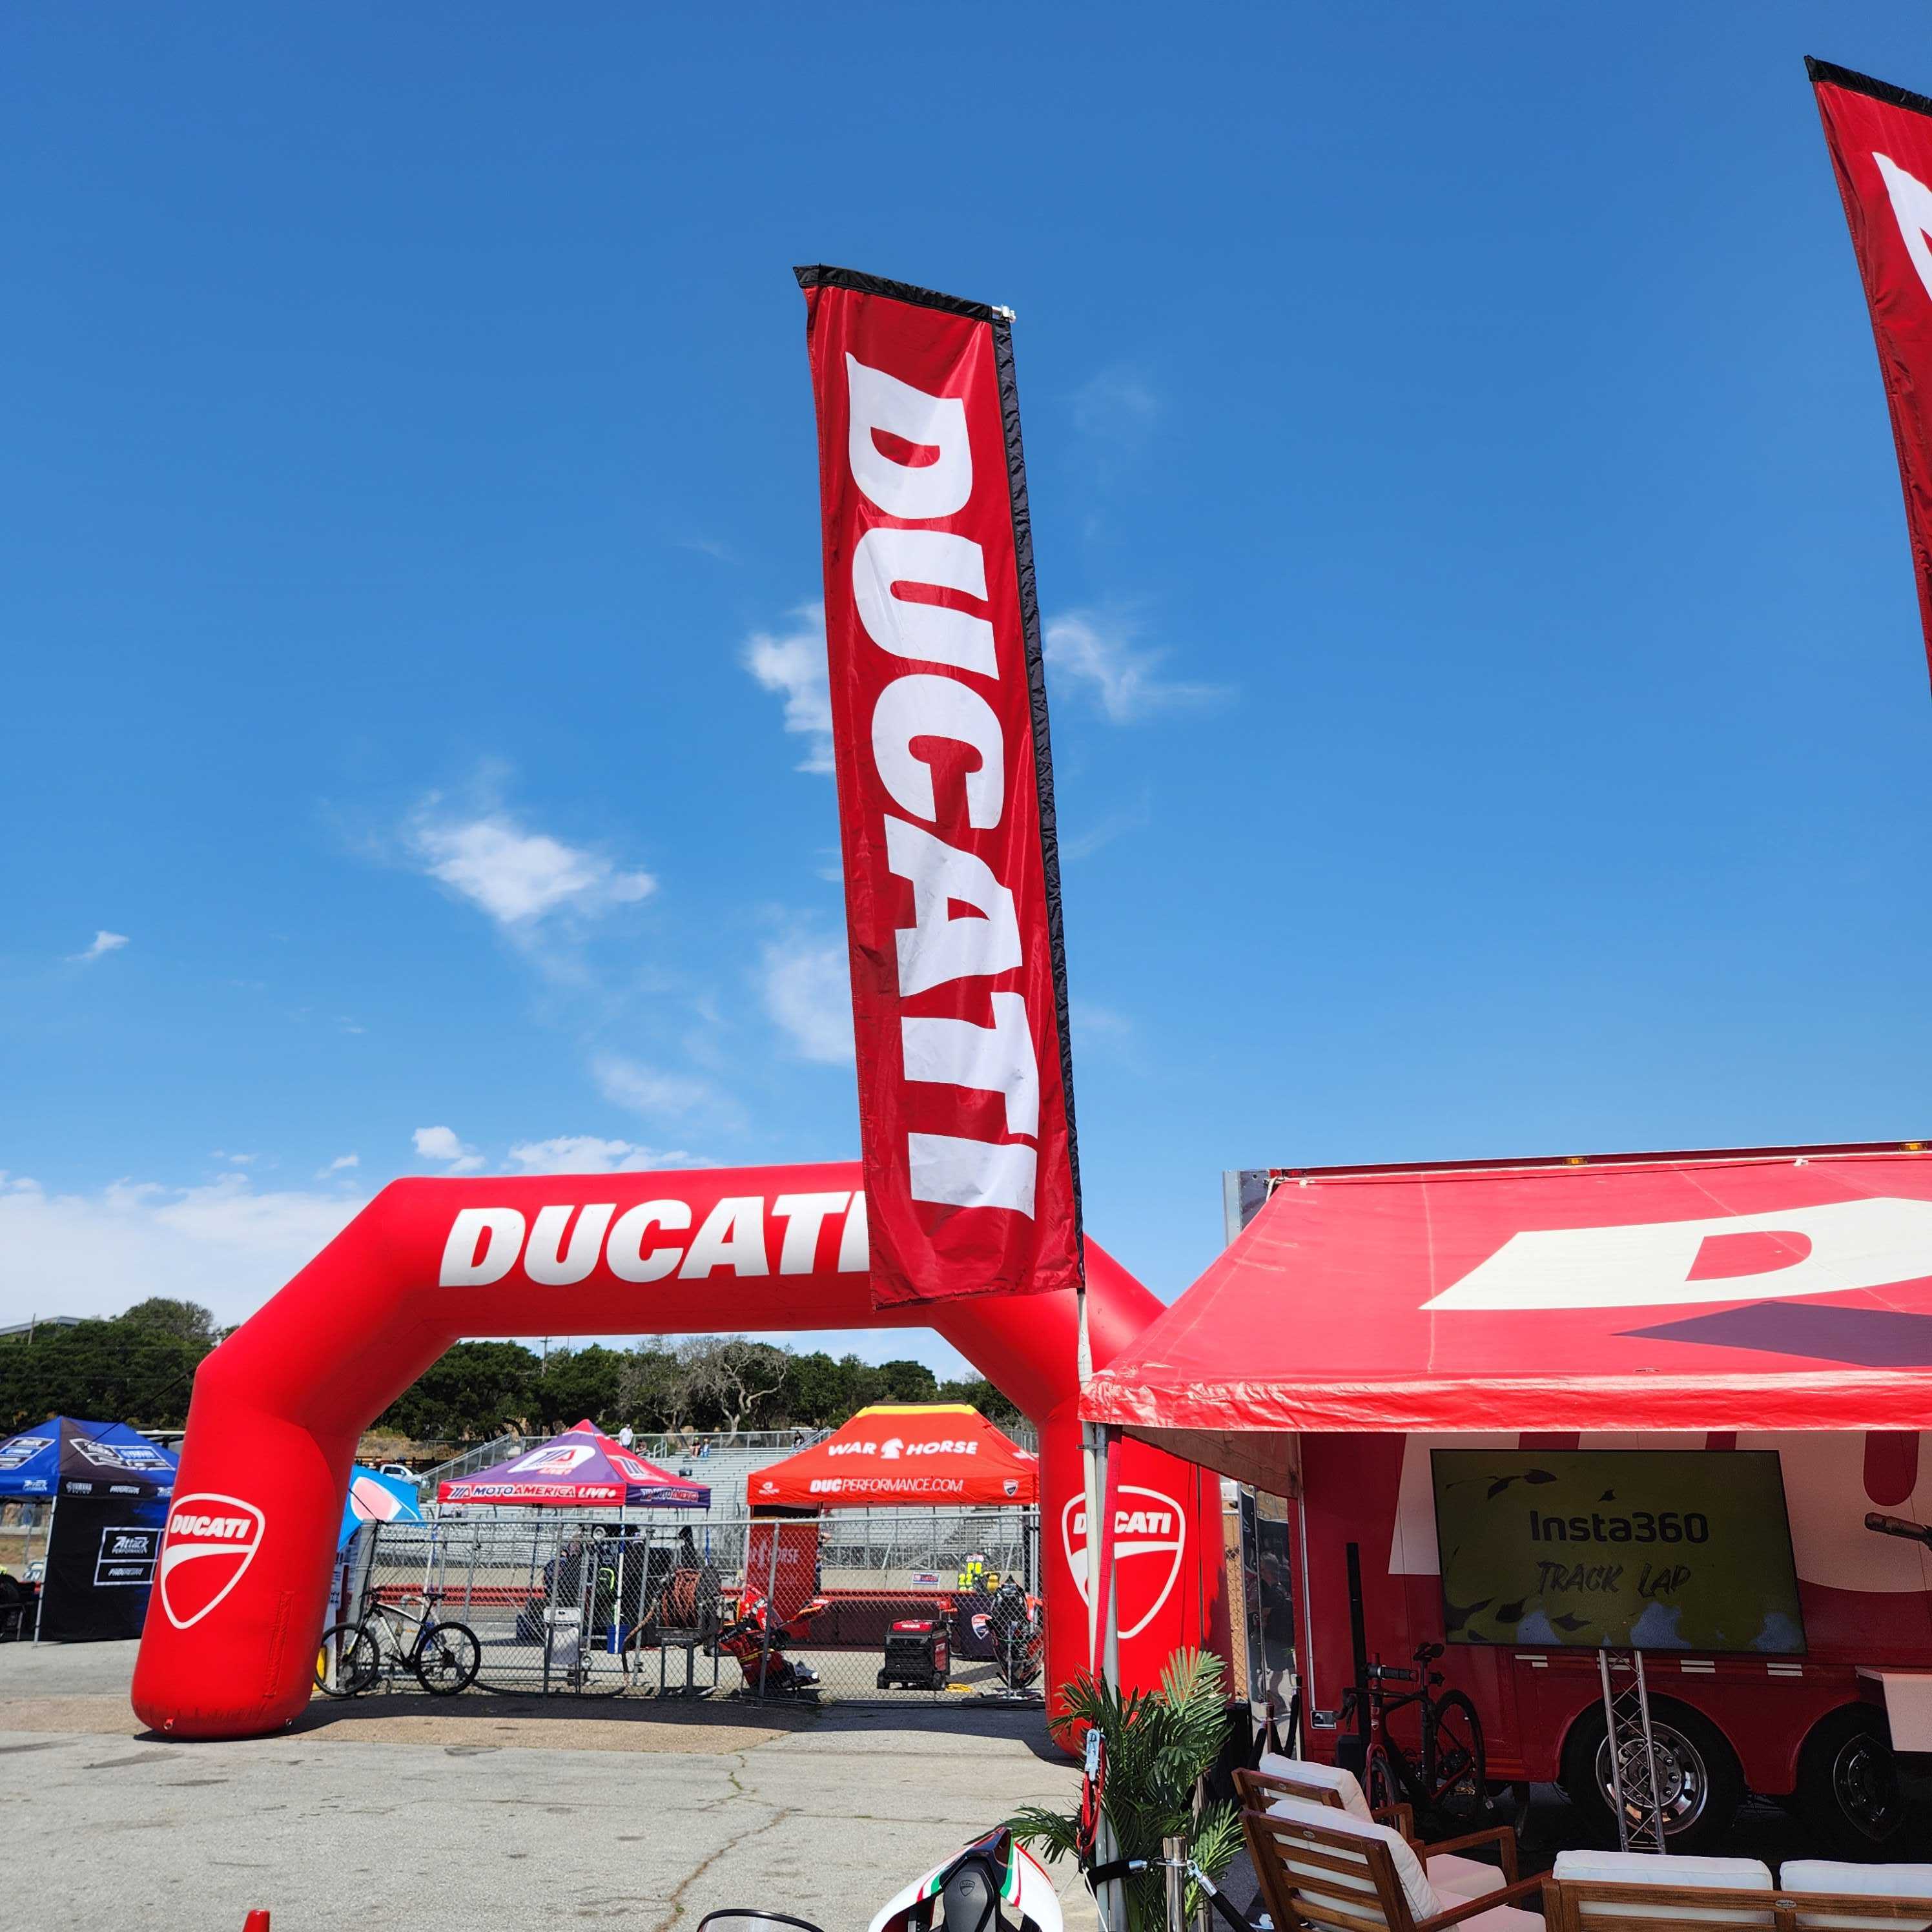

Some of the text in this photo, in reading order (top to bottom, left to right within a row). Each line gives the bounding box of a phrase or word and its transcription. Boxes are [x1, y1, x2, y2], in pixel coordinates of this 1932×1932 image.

[845, 351, 1040, 1221] DUCATI
[828, 1439, 979, 1456] WAR HORSE
[473, 1485, 576, 1498] MOTOAMERICA
[810, 1477, 964, 1493] DUCPERFORMANCE.COM
[170, 1514, 252, 1539] DUCATI
[1073, 1511, 1172, 1534] DCATI
[1529, 1510, 1709, 1543] Insta360
[1536, 1559, 1692, 1598] TRACK LAP
